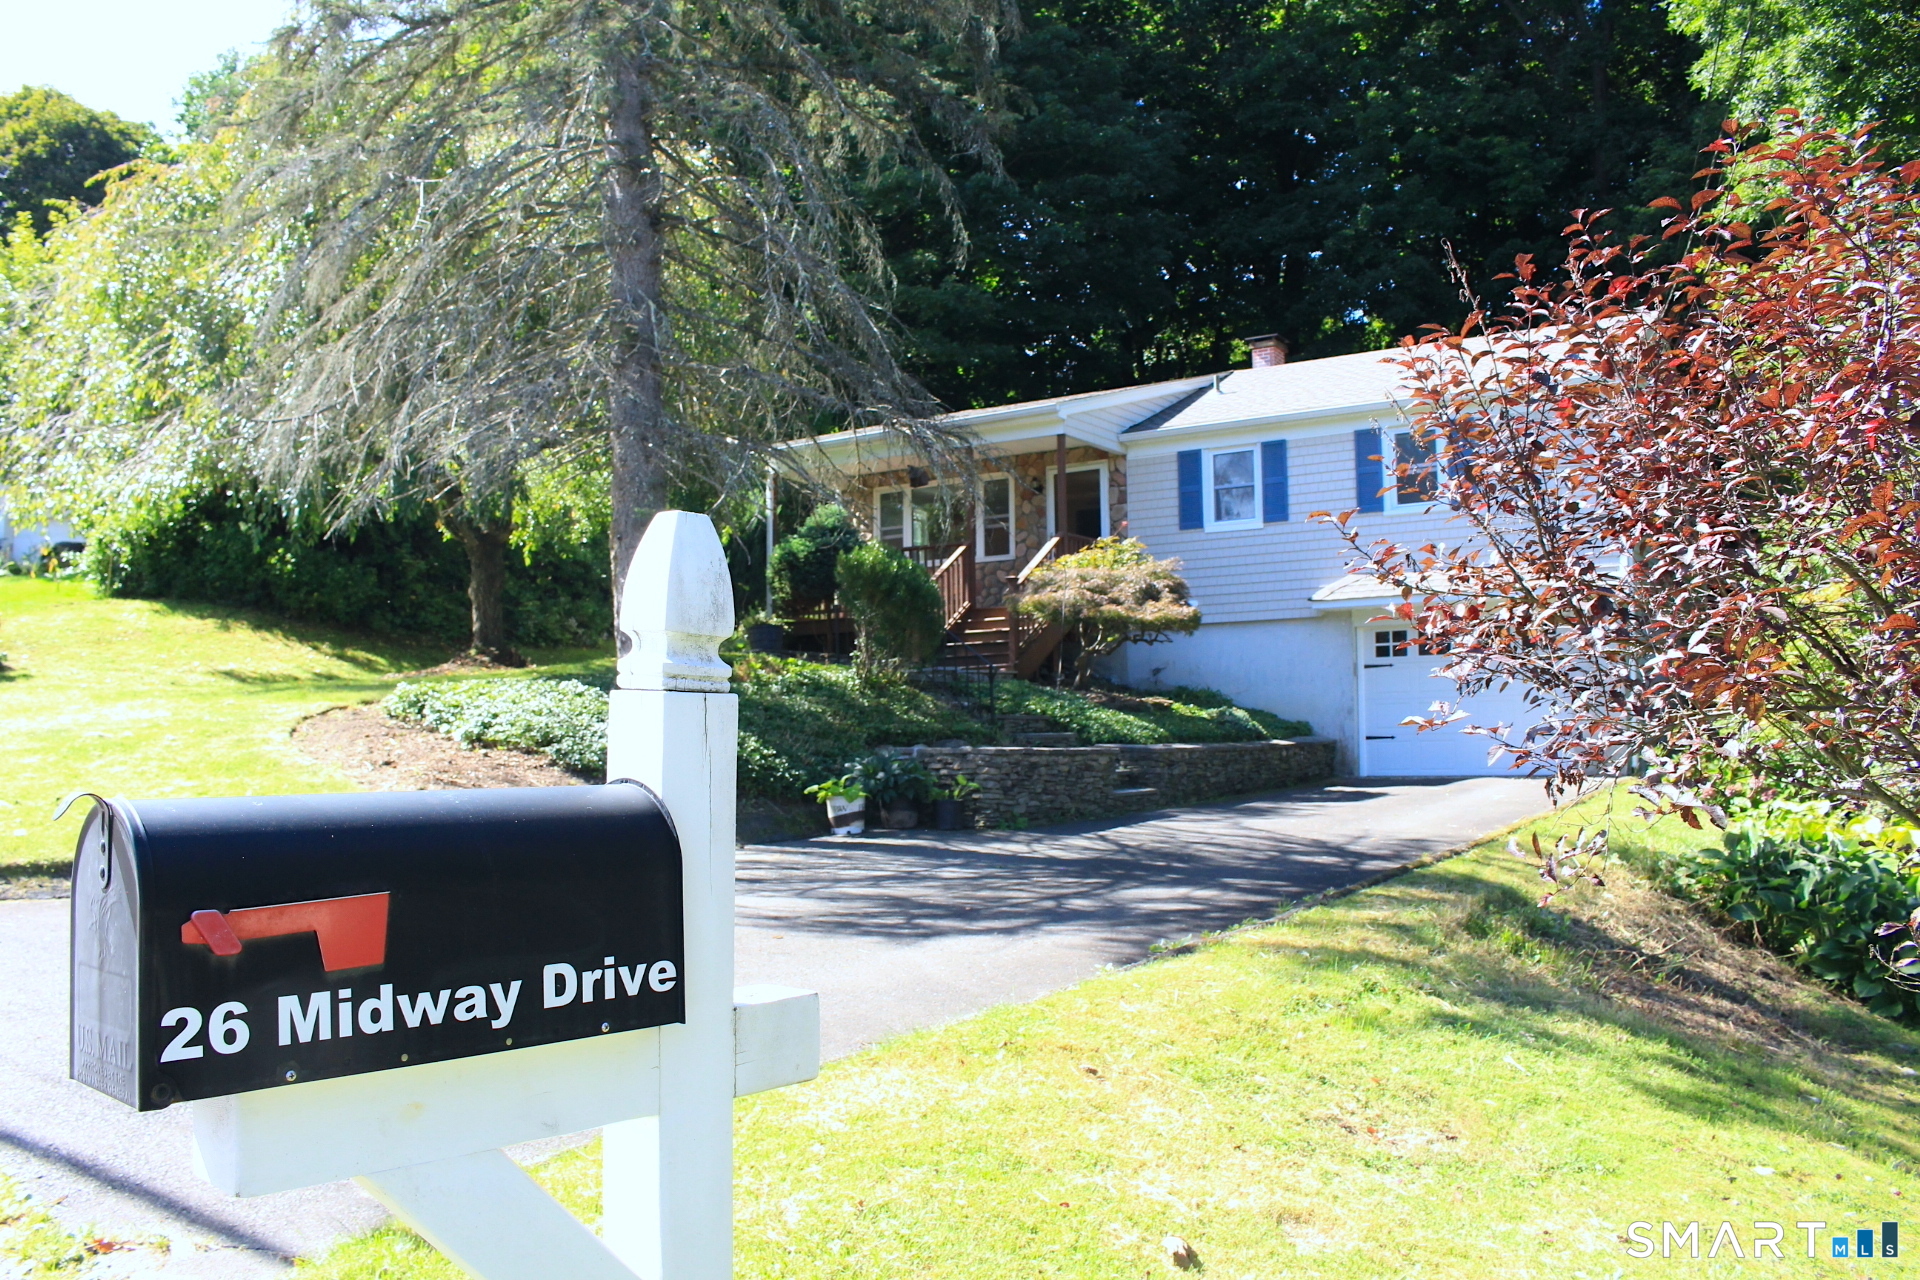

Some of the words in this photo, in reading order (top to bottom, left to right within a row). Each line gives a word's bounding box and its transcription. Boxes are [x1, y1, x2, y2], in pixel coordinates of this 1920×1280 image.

[160, 1002, 250, 1063] 26
[278, 980, 523, 1047] Midway
[542, 956, 677, 1009] Drive
[98, 1033, 133, 1073] MAIL
